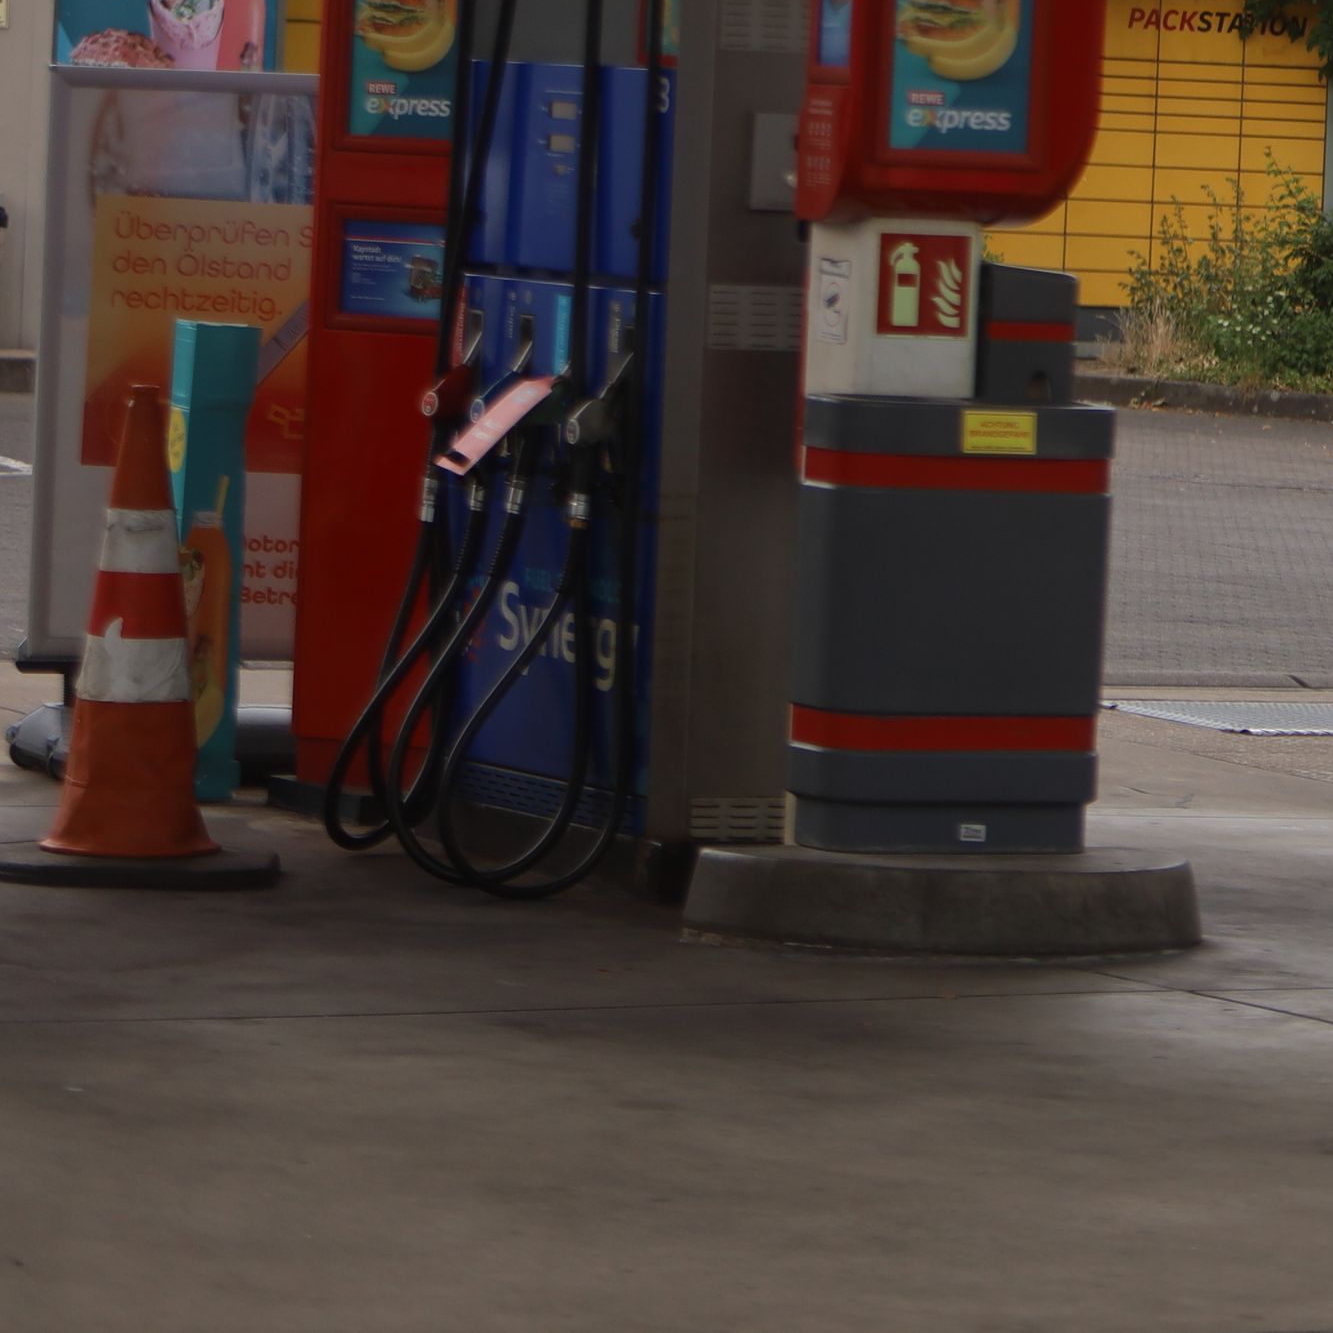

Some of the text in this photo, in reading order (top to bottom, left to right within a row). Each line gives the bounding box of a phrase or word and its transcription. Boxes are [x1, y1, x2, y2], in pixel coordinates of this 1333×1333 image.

[367, 82, 397, 95] REWE
[908, 92, 944, 106] REWE
[365, 94, 452, 119] express
[904, 105, 1013, 134] express
[114, 210, 291, 252] Überprüfen
[112, 250, 167, 275] den
[112, 286, 282, 322] rechtzeitig.
